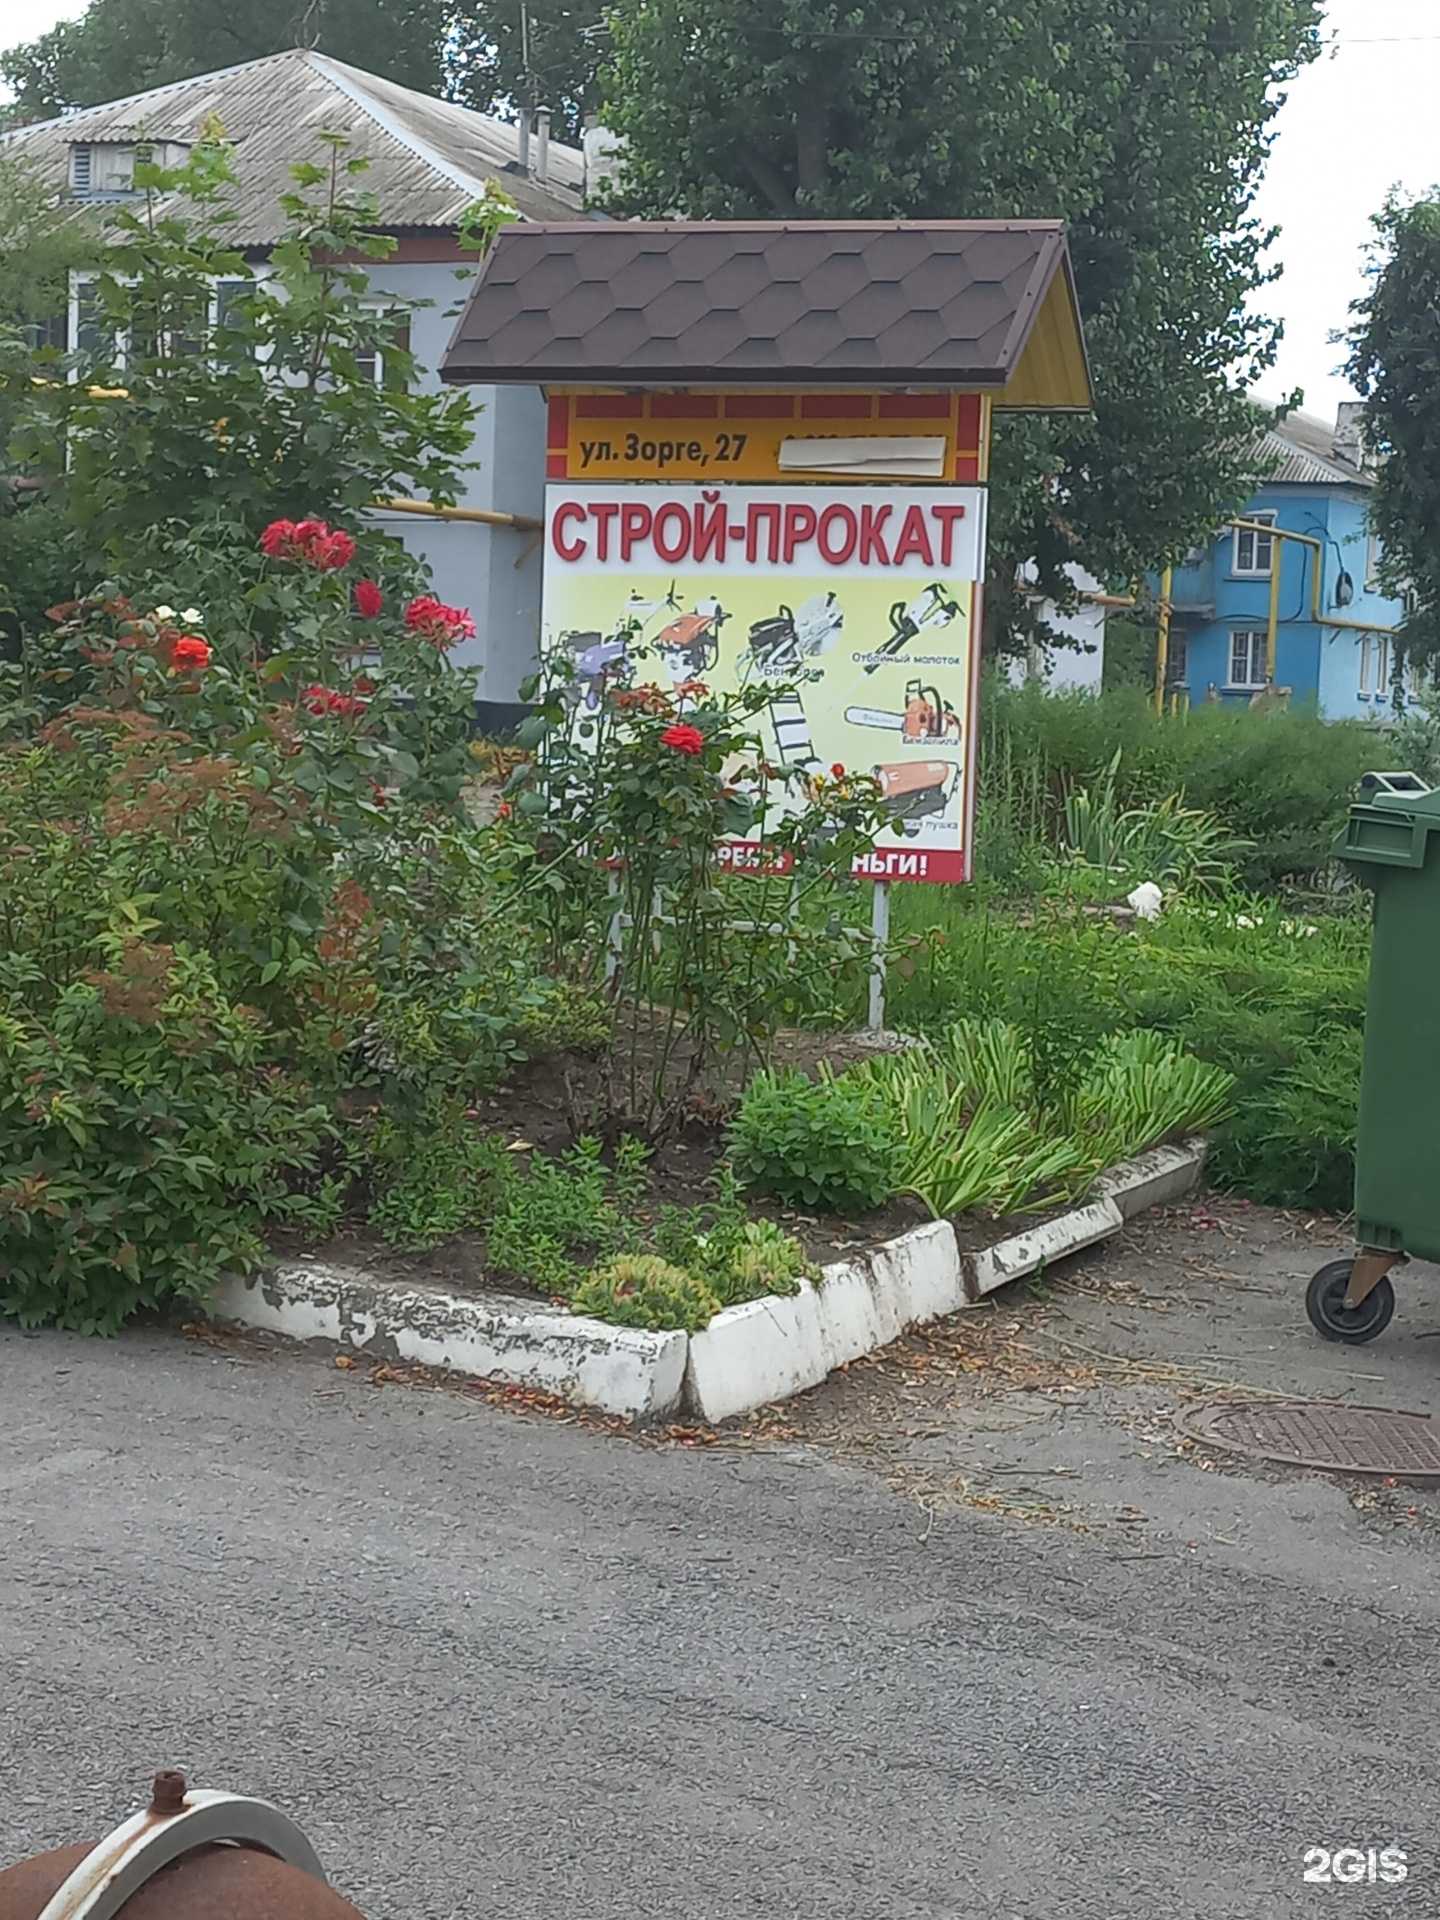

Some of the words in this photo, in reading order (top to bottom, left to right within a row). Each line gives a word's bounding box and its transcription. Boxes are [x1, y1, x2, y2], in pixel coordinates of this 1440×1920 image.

[623, 432, 710, 469] Зорге,
[714, 433, 748, 462] 27
[551, 489, 966, 567] СТРОЙ-ПРОКАТ
[913, 655, 961, 665] молоток
